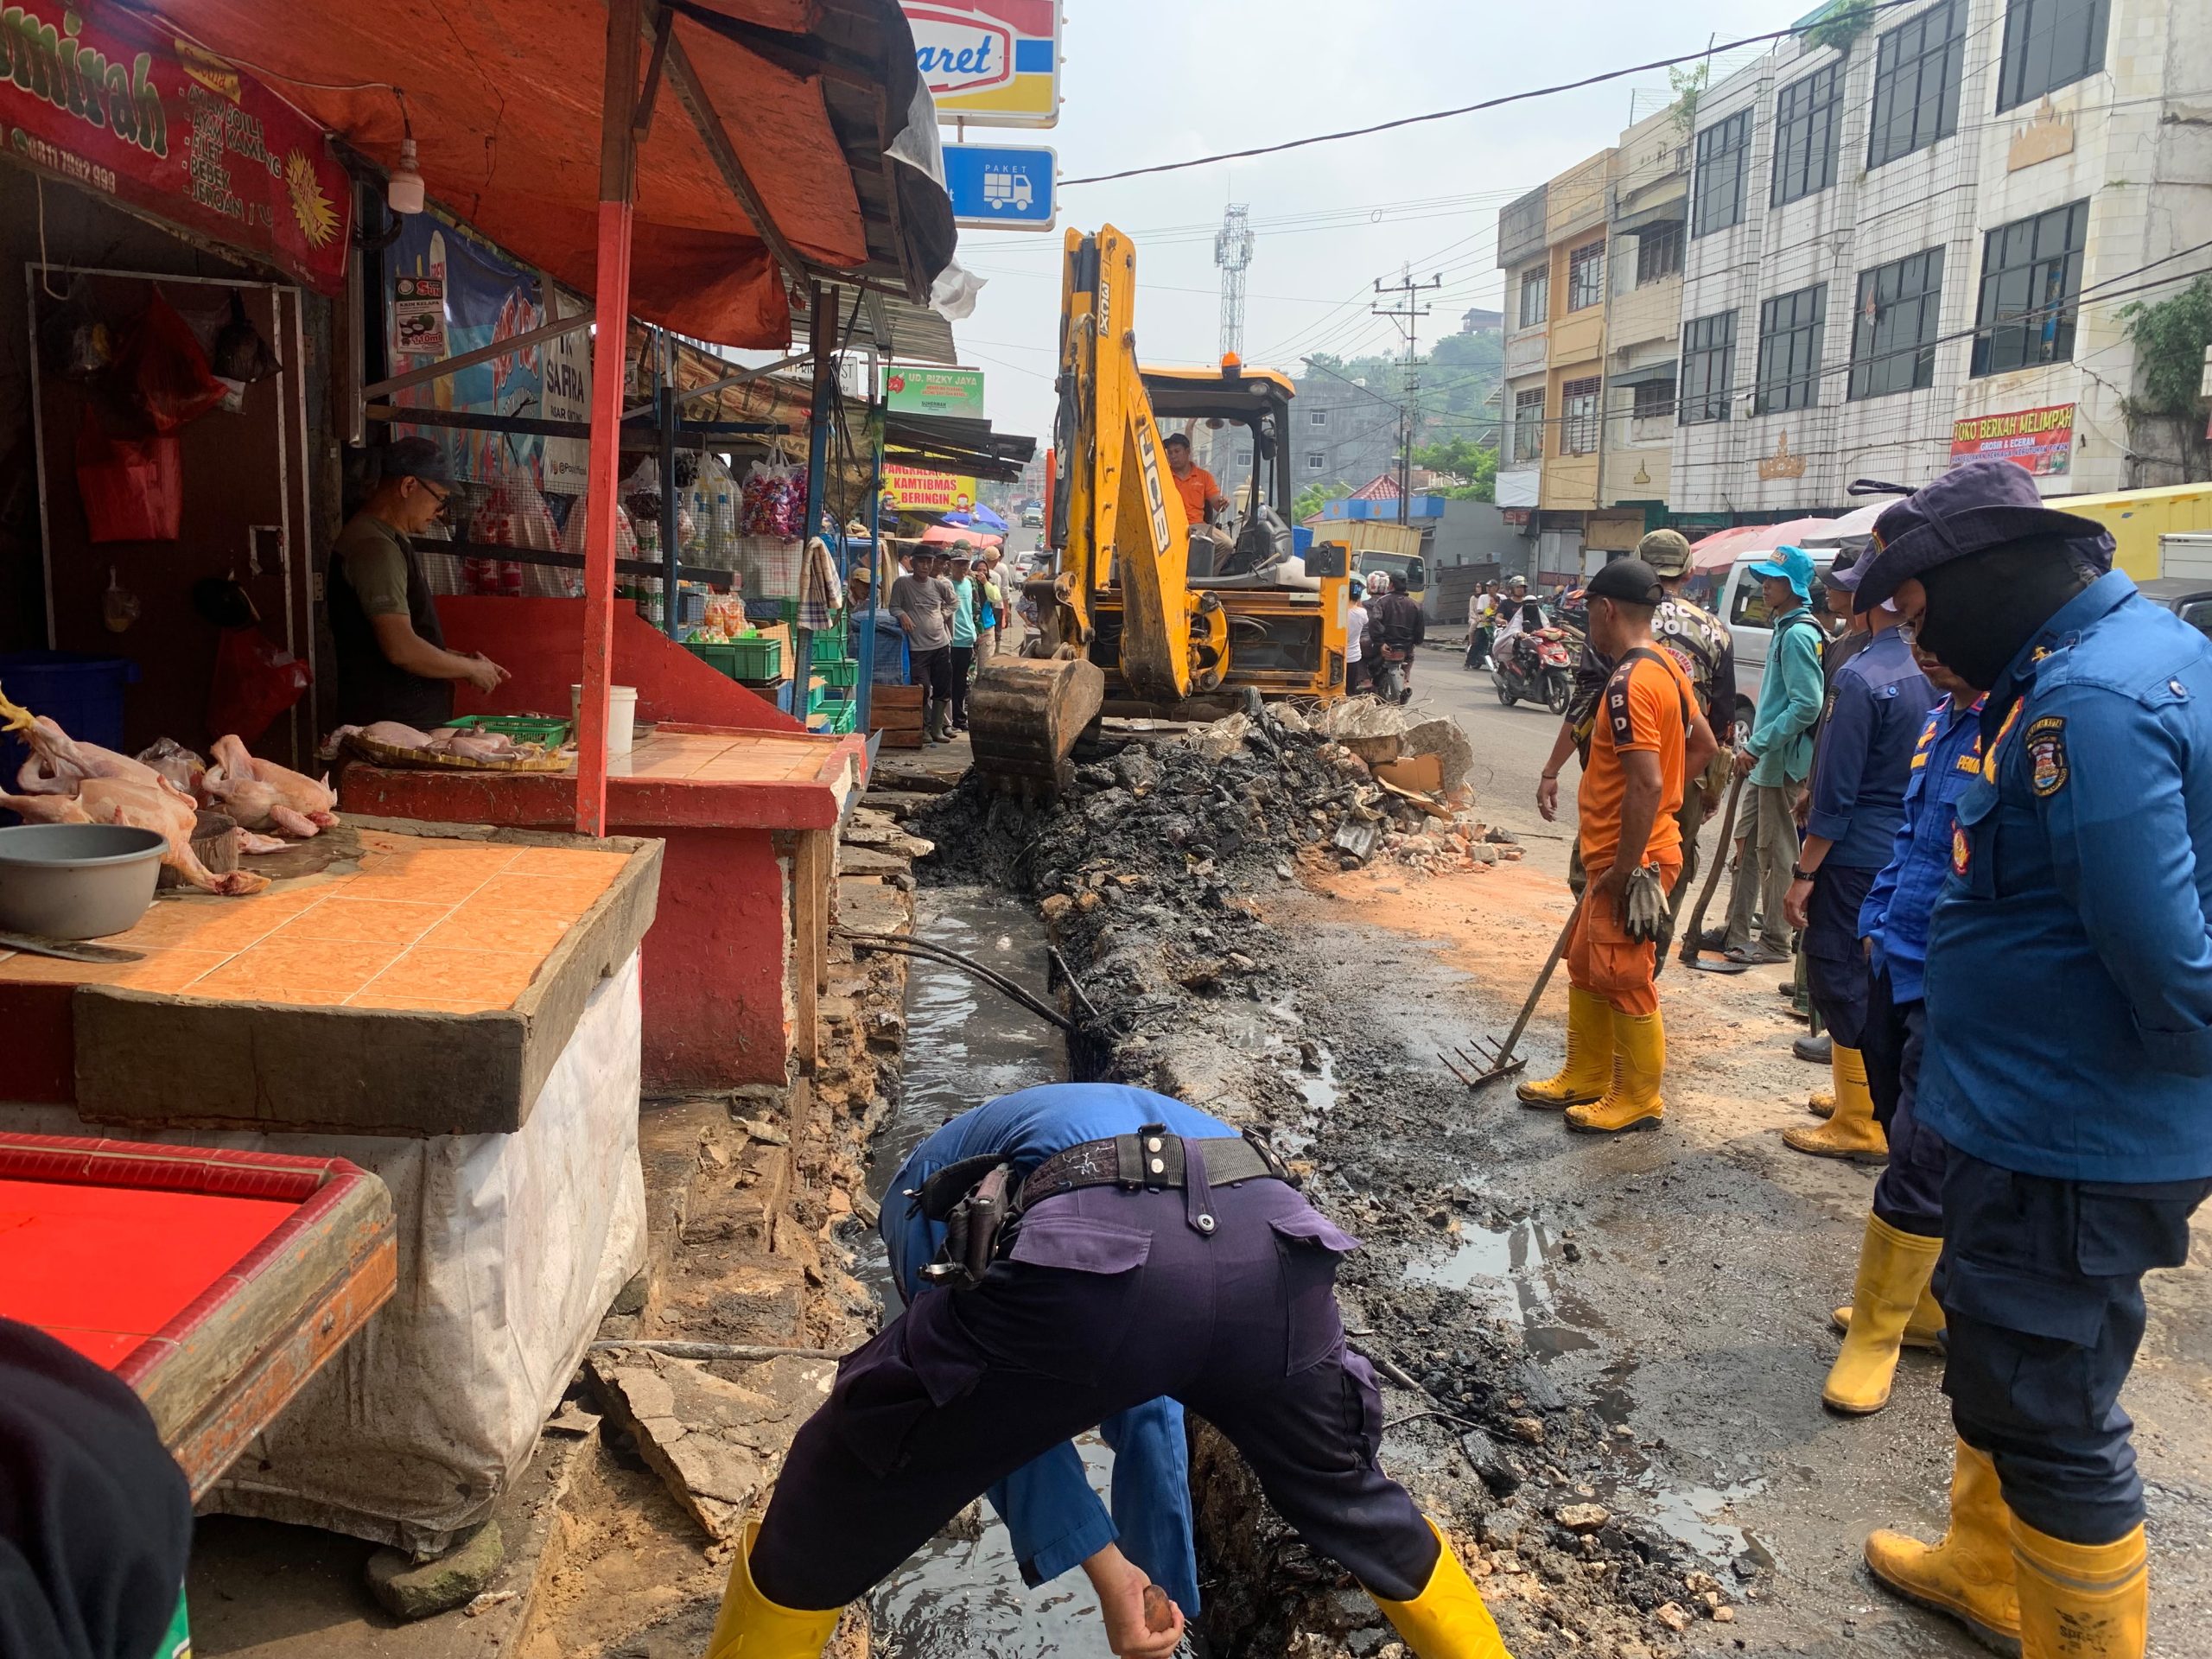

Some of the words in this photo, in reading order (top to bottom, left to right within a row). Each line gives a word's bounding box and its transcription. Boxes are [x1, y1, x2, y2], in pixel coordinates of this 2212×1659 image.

[193, 110, 224, 145] AYAM
[192, 130, 224, 168] FILET
[191, 155, 232, 194] BEBEK
[985, 164, 1027, 174] PAKET
[192, 180, 244, 221] JEROAN
[926, 374, 952, 385] RIZKY
[955, 376, 977, 385] JAYA
[1955, 422, 1977, 442] TOKO
[1980, 416, 2017, 439] BERKAH
[2019, 407, 2073, 434] MELIMPAH
[894, 478, 957, 491] KAMTIBMAS
[901, 493, 950, 505] BERINGIN
[1140, 429, 1169, 552] JCB
[1650, 618, 1693, 636] POL
